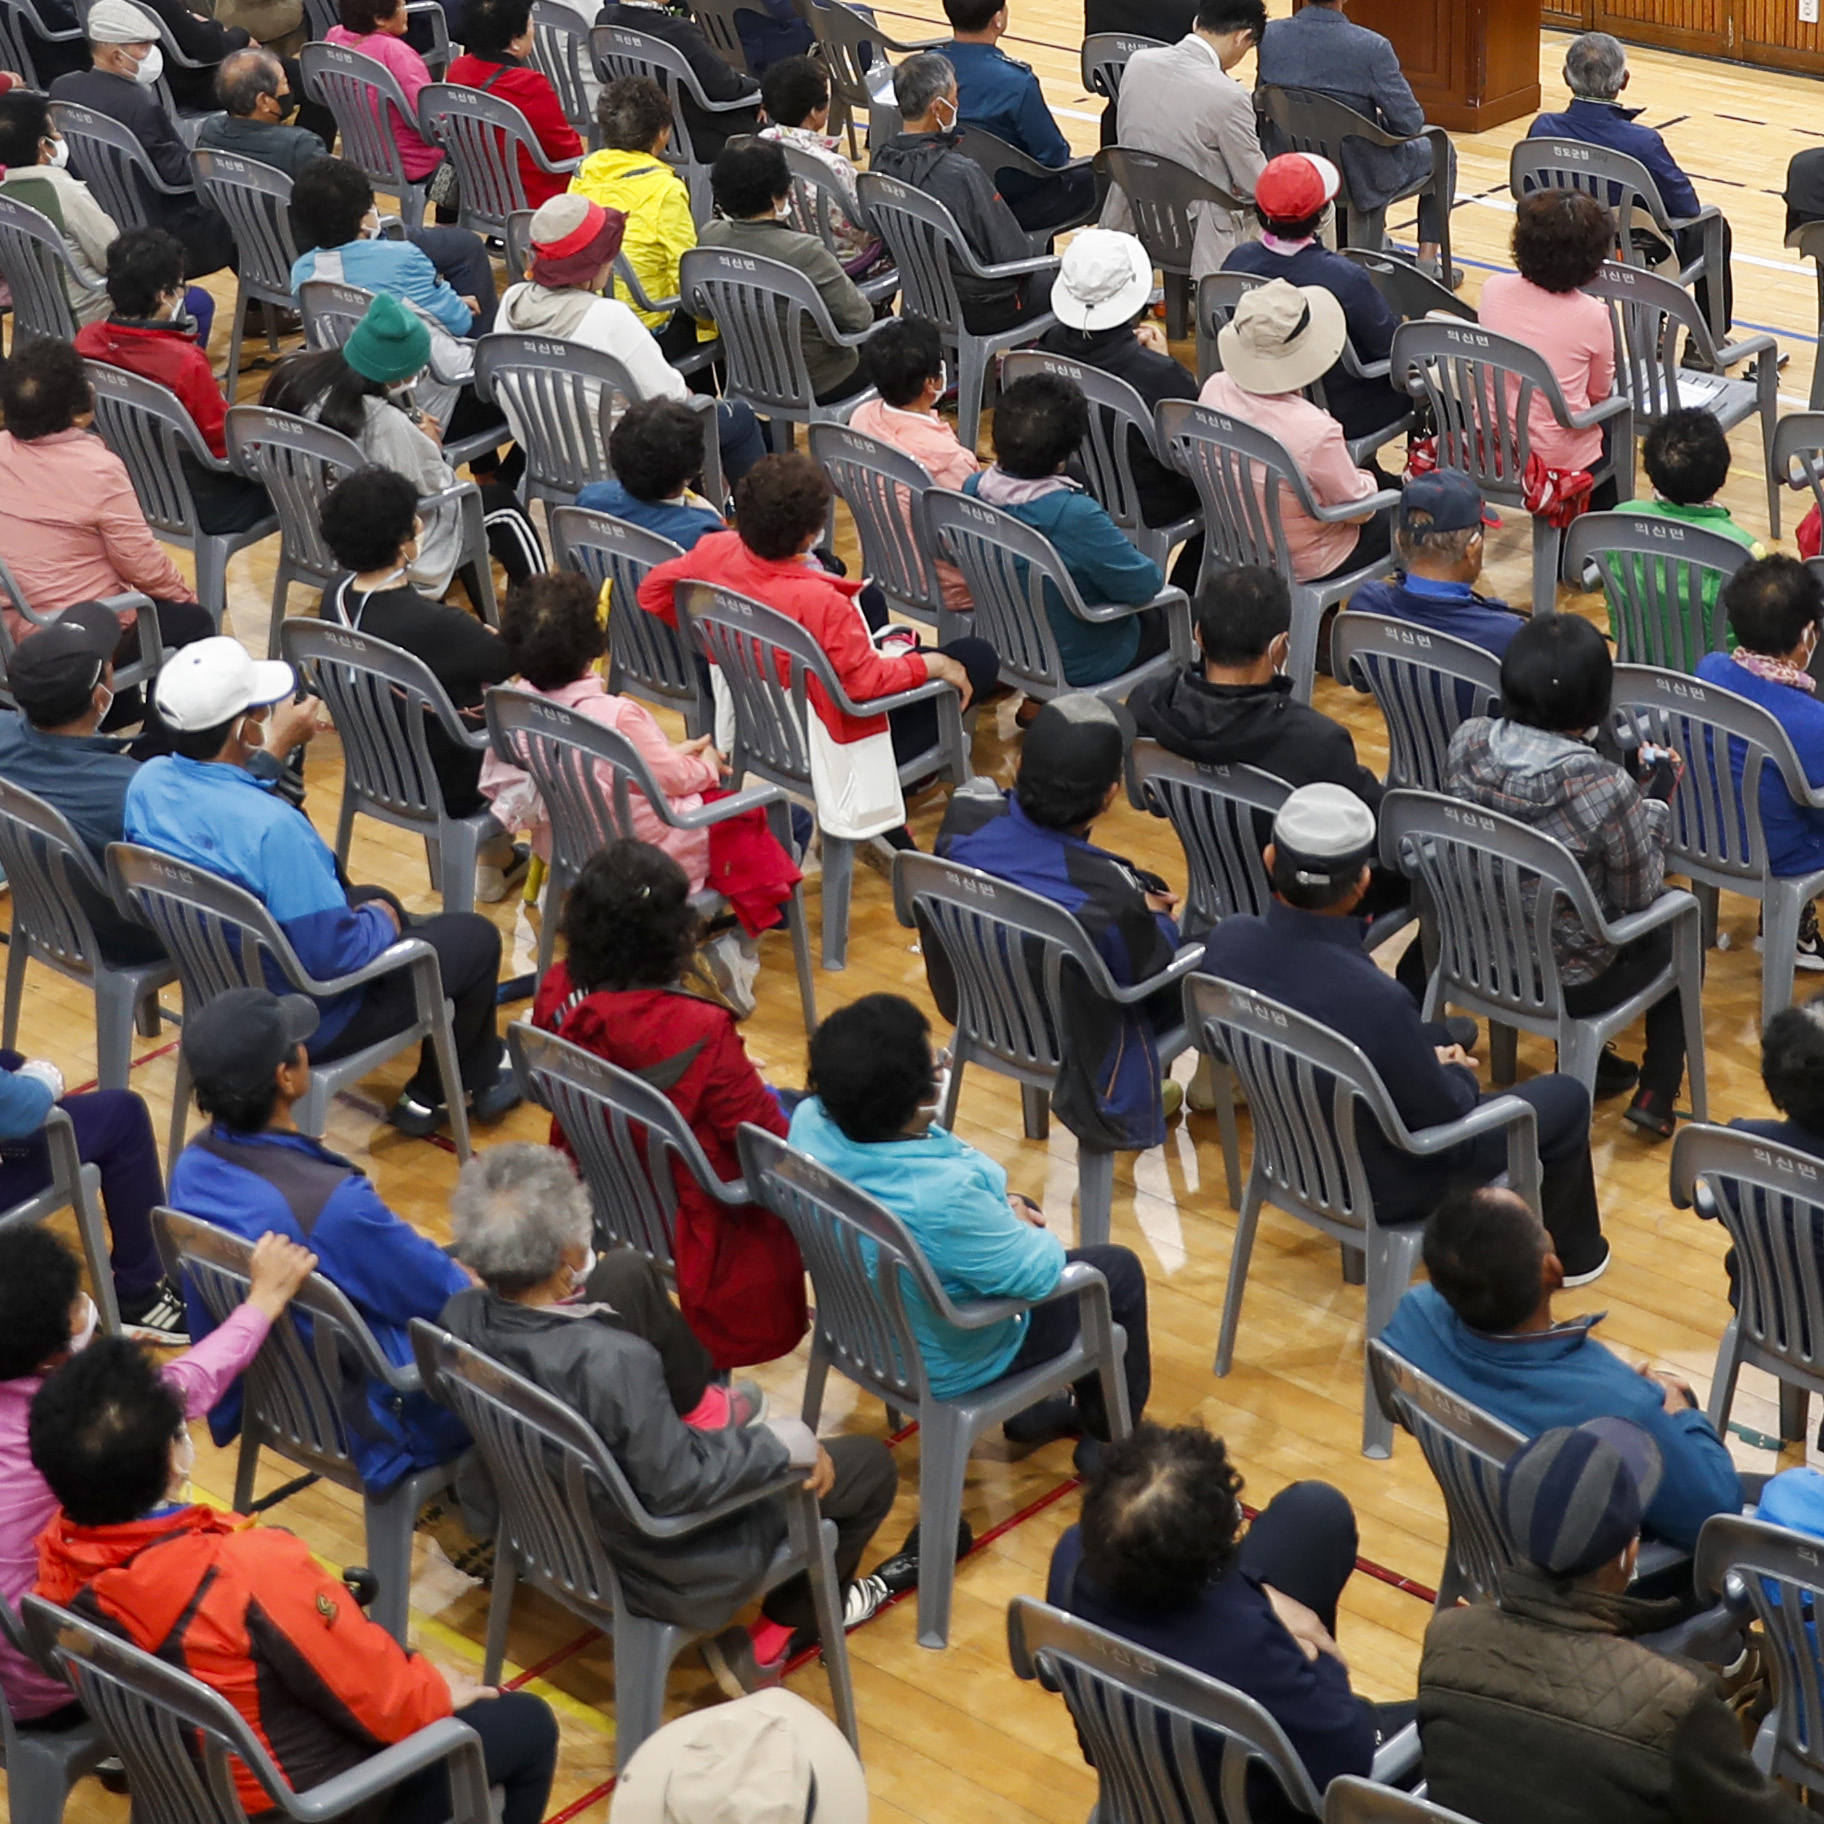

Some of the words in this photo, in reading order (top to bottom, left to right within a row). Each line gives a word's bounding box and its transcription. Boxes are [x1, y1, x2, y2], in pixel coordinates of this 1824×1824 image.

[1553, 145, 1590, 161] 진도군청
[719, 255, 756, 271] 의신면
[524, 340, 567, 356] 의신면
[1447, 329, 1489, 348] 의신면
[588, 518, 625, 537] 의신면
[1634, 522, 1685, 541] 의신면
[1385, 627, 1433, 648] 의신면
[1444, 806, 1496, 831] 의신면
[1753, 1148, 1817, 1181] 의신면
